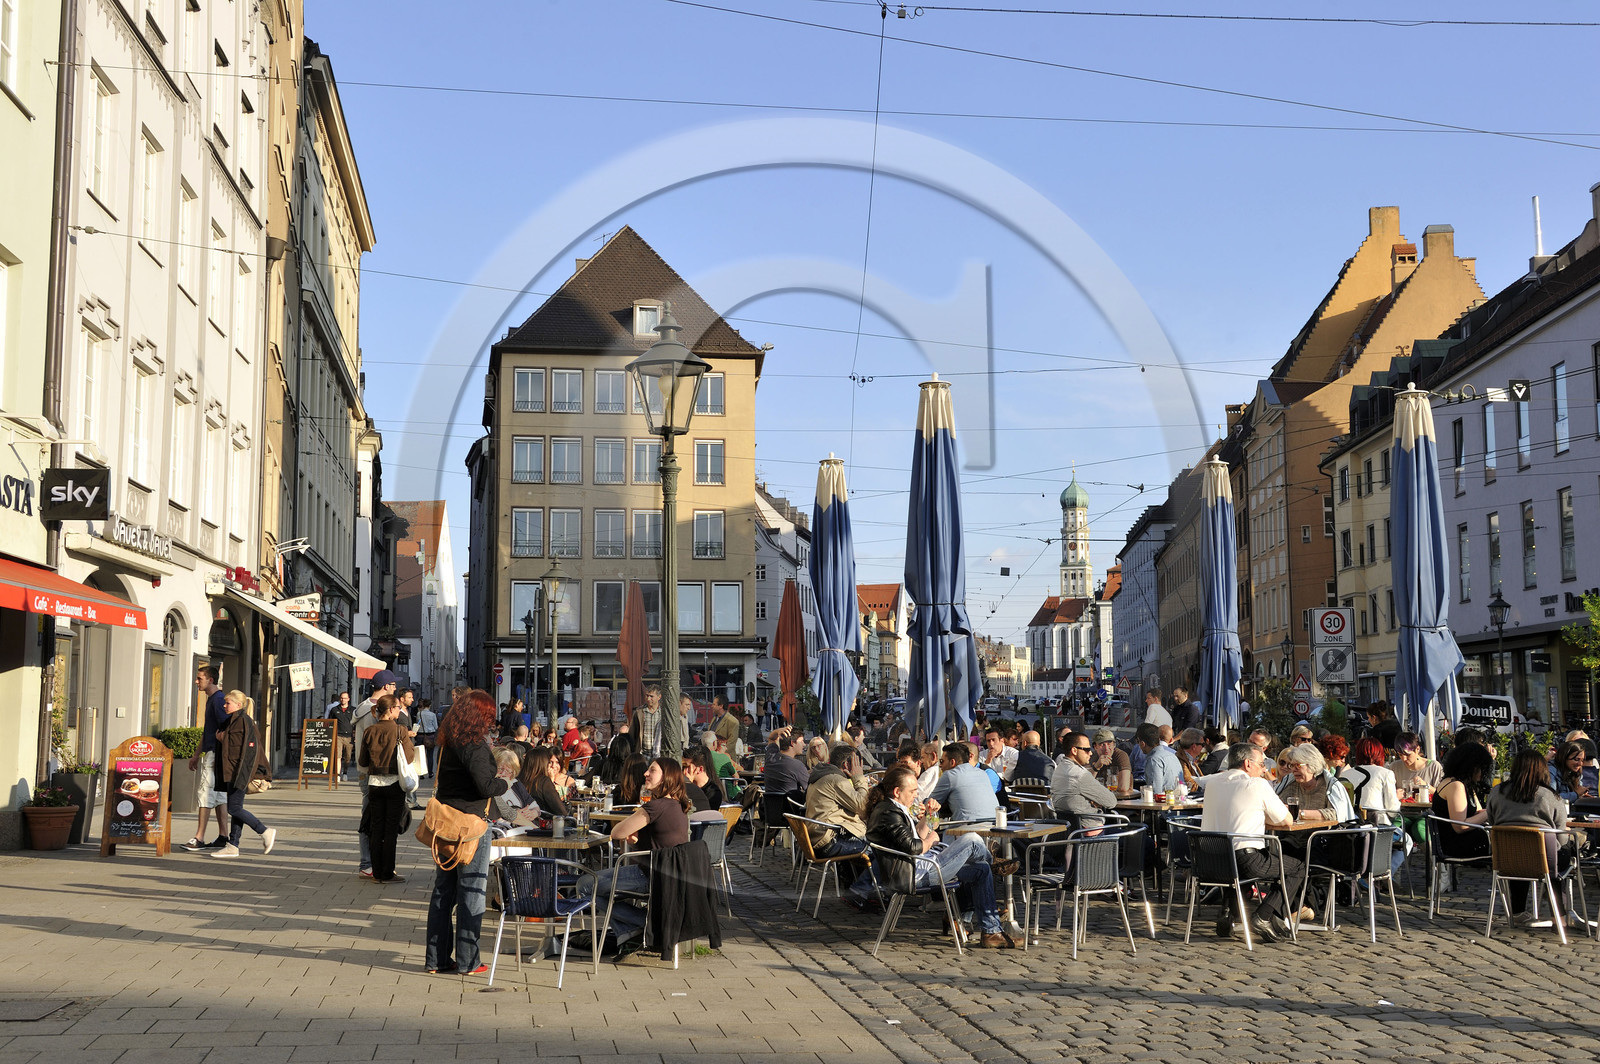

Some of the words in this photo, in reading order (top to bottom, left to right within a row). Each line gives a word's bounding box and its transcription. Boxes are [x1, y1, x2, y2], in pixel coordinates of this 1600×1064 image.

[0, 475, 33, 517] STA
[51, 480, 100, 508] sky
[113, 511, 142, 550] BAUER
[149, 525, 172, 560] BAUER
[55, 600, 83, 617] Restaurant
[87, 606, 97, 619] Bar
[1325, 617, 1340, 629] 30
[1297, 704, 1306, 712] 10
[1462, 705, 1508, 719] Domicil
